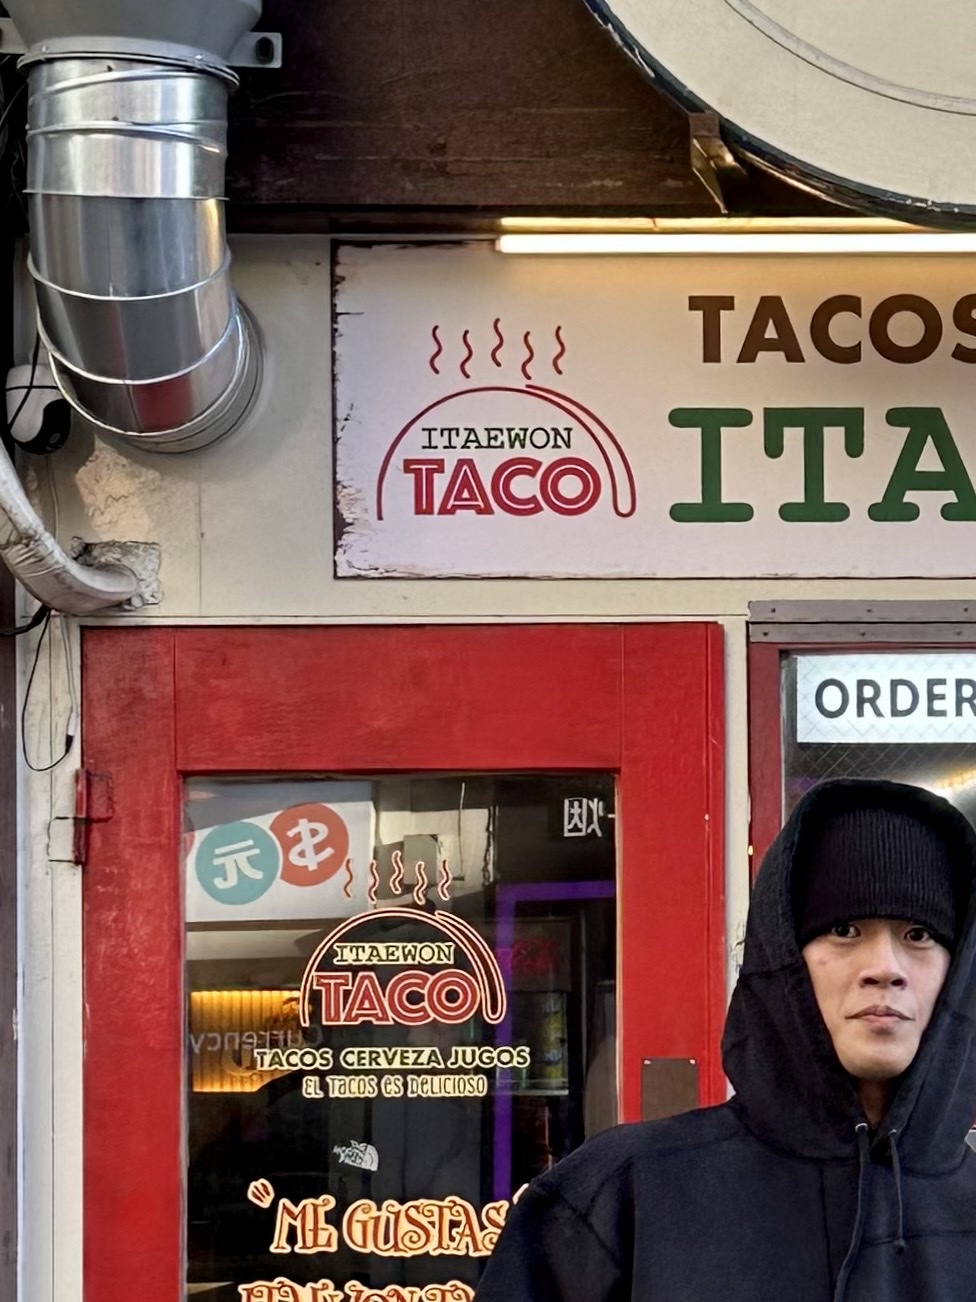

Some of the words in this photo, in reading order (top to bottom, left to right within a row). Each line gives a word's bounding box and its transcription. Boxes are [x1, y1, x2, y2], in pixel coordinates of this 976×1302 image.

[421, 426, 573, 450] ITAEWON
[403, 457, 602, 516] TACO
[333, 943, 454, 964] ITAEWON
[313, 969, 482, 1026] TACO
[254, 1048, 332, 1070] TACOS
[340, 1047, 443, 1069] CERVEZA
[447, 1046, 531, 1068] JUGOS
[269, 1194, 338, 1254] ME
[343, 1195, 509, 1257] GUSTAS
